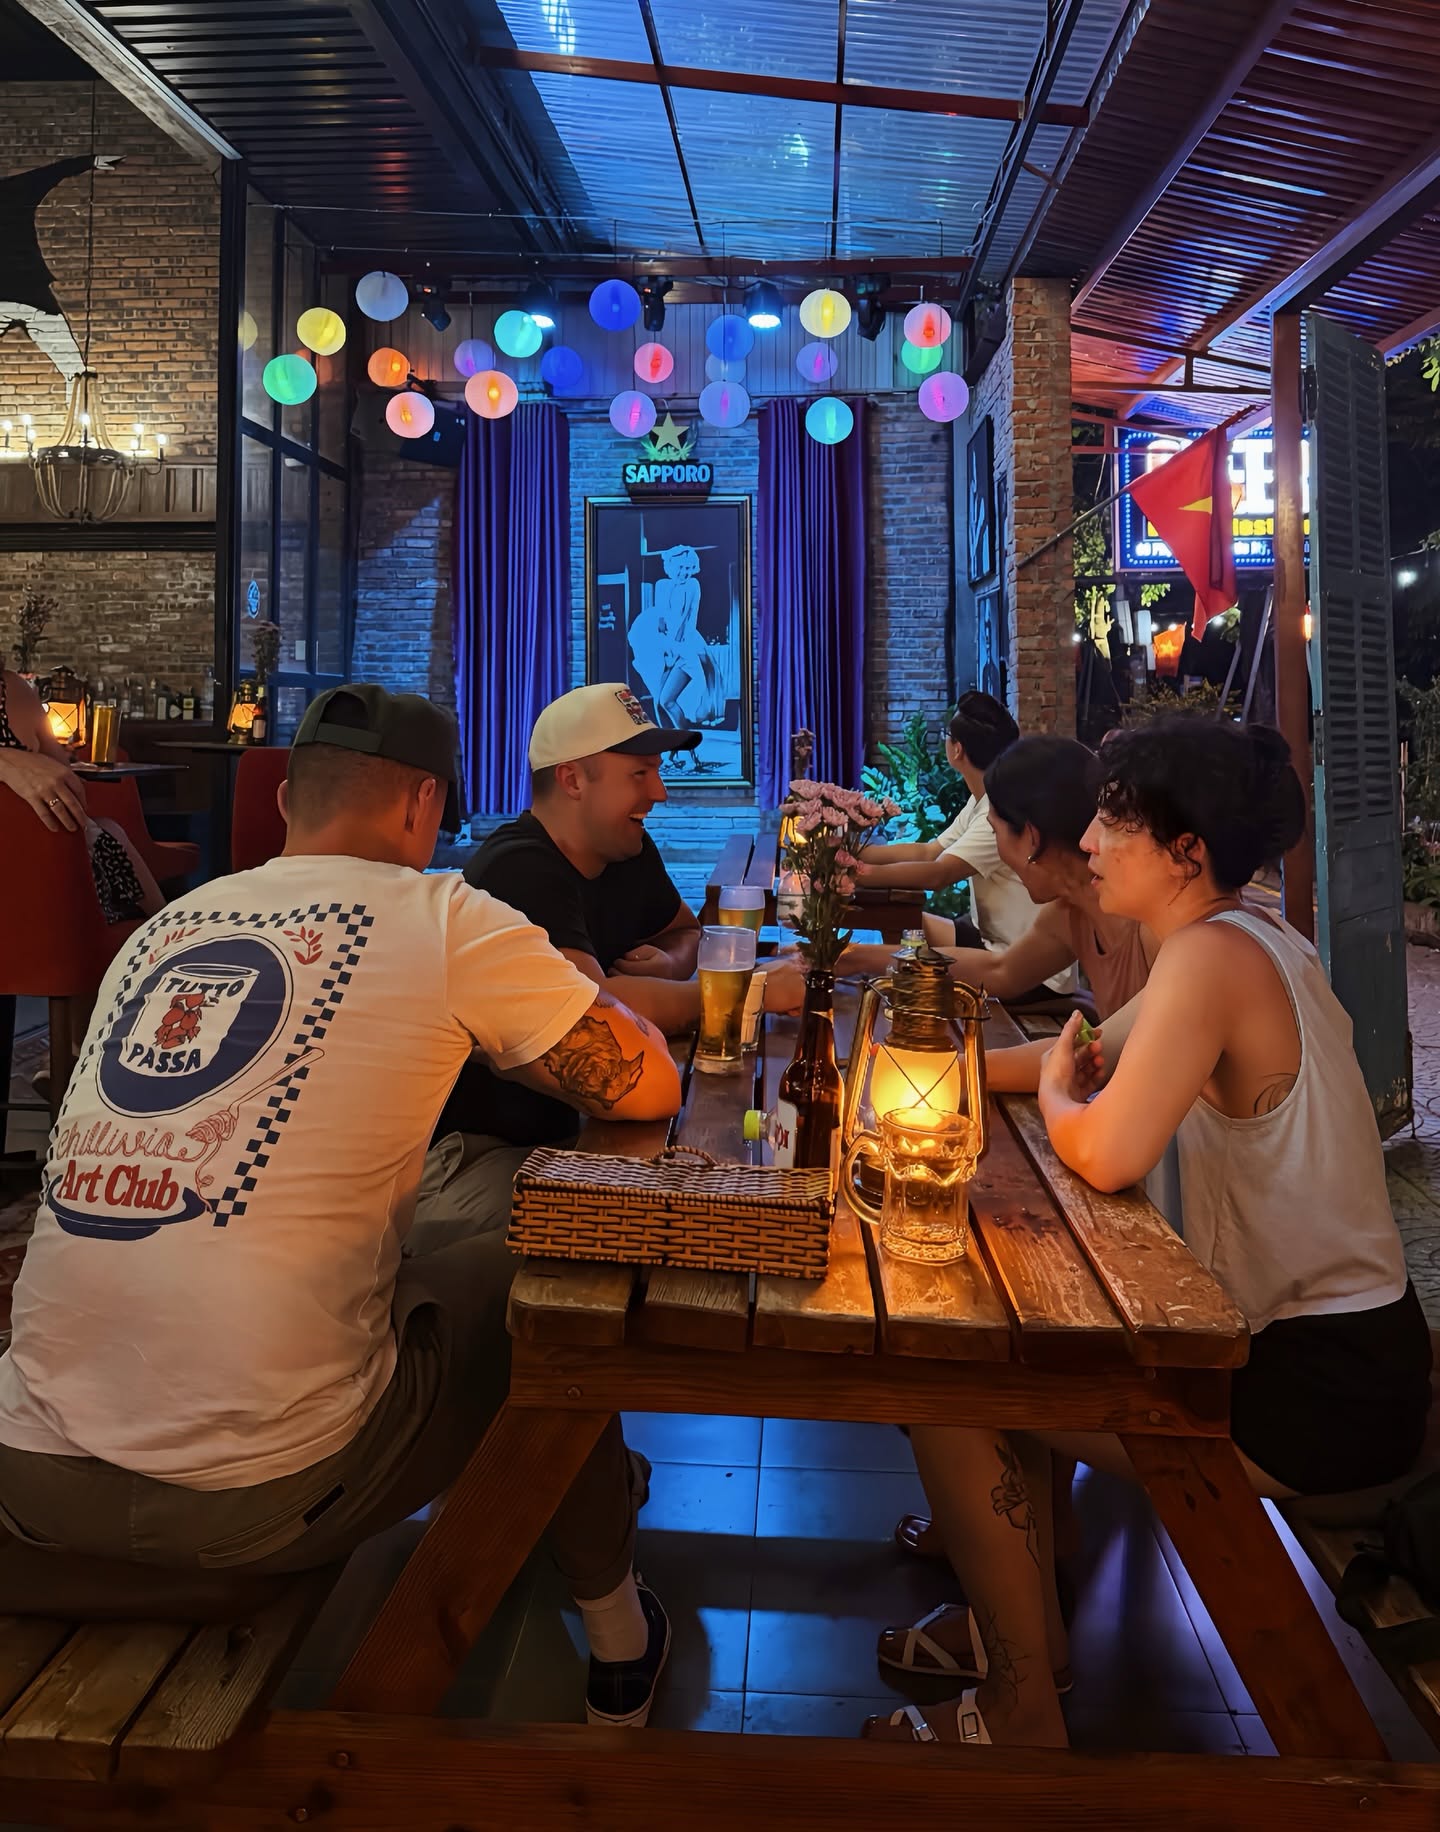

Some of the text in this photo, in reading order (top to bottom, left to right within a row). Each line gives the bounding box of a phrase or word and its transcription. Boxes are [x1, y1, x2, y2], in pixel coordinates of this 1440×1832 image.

[625, 464, 711, 484] SAPPORO
[164, 977, 245, 998] TUTTO
[126, 1042, 201, 1074] PASSA
[56, 1159, 180, 1211] Art Club
